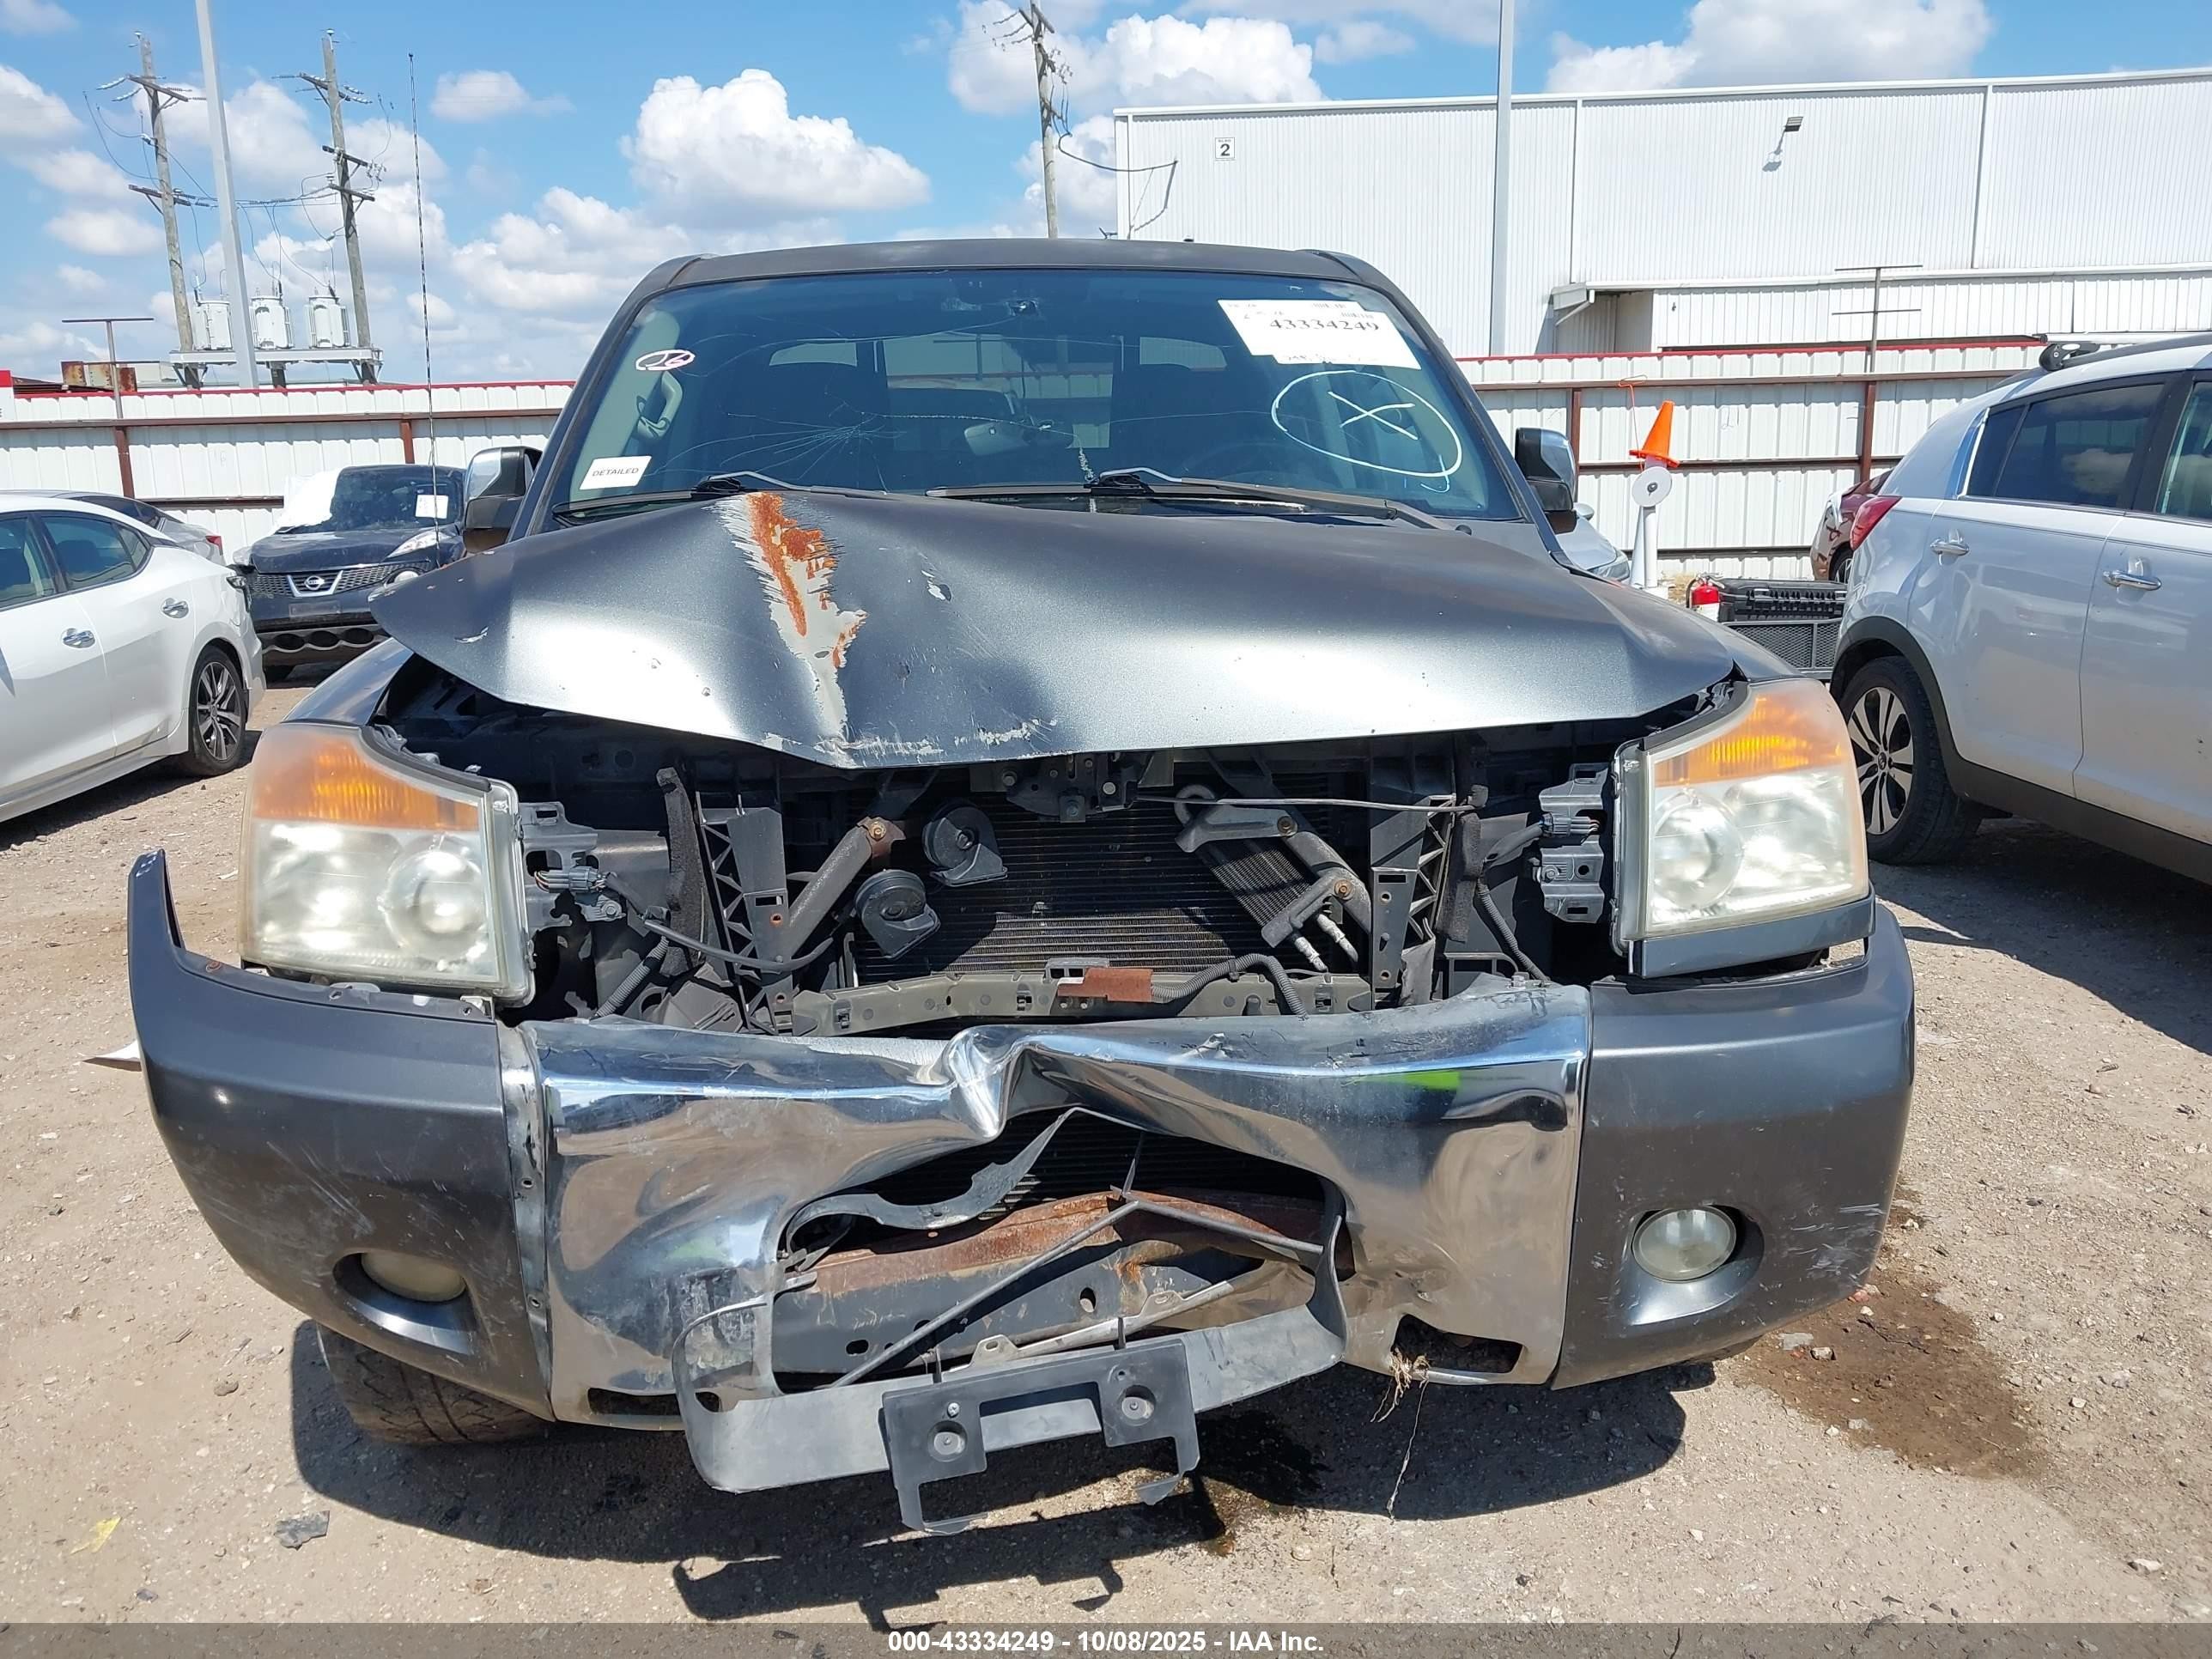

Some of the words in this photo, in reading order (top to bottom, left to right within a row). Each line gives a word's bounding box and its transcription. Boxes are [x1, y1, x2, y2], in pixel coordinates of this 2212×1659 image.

[1220, 143, 1230, 156] 2
[1270, 319, 1379, 331] 43334249
[592, 467, 640, 477] DETAILED
